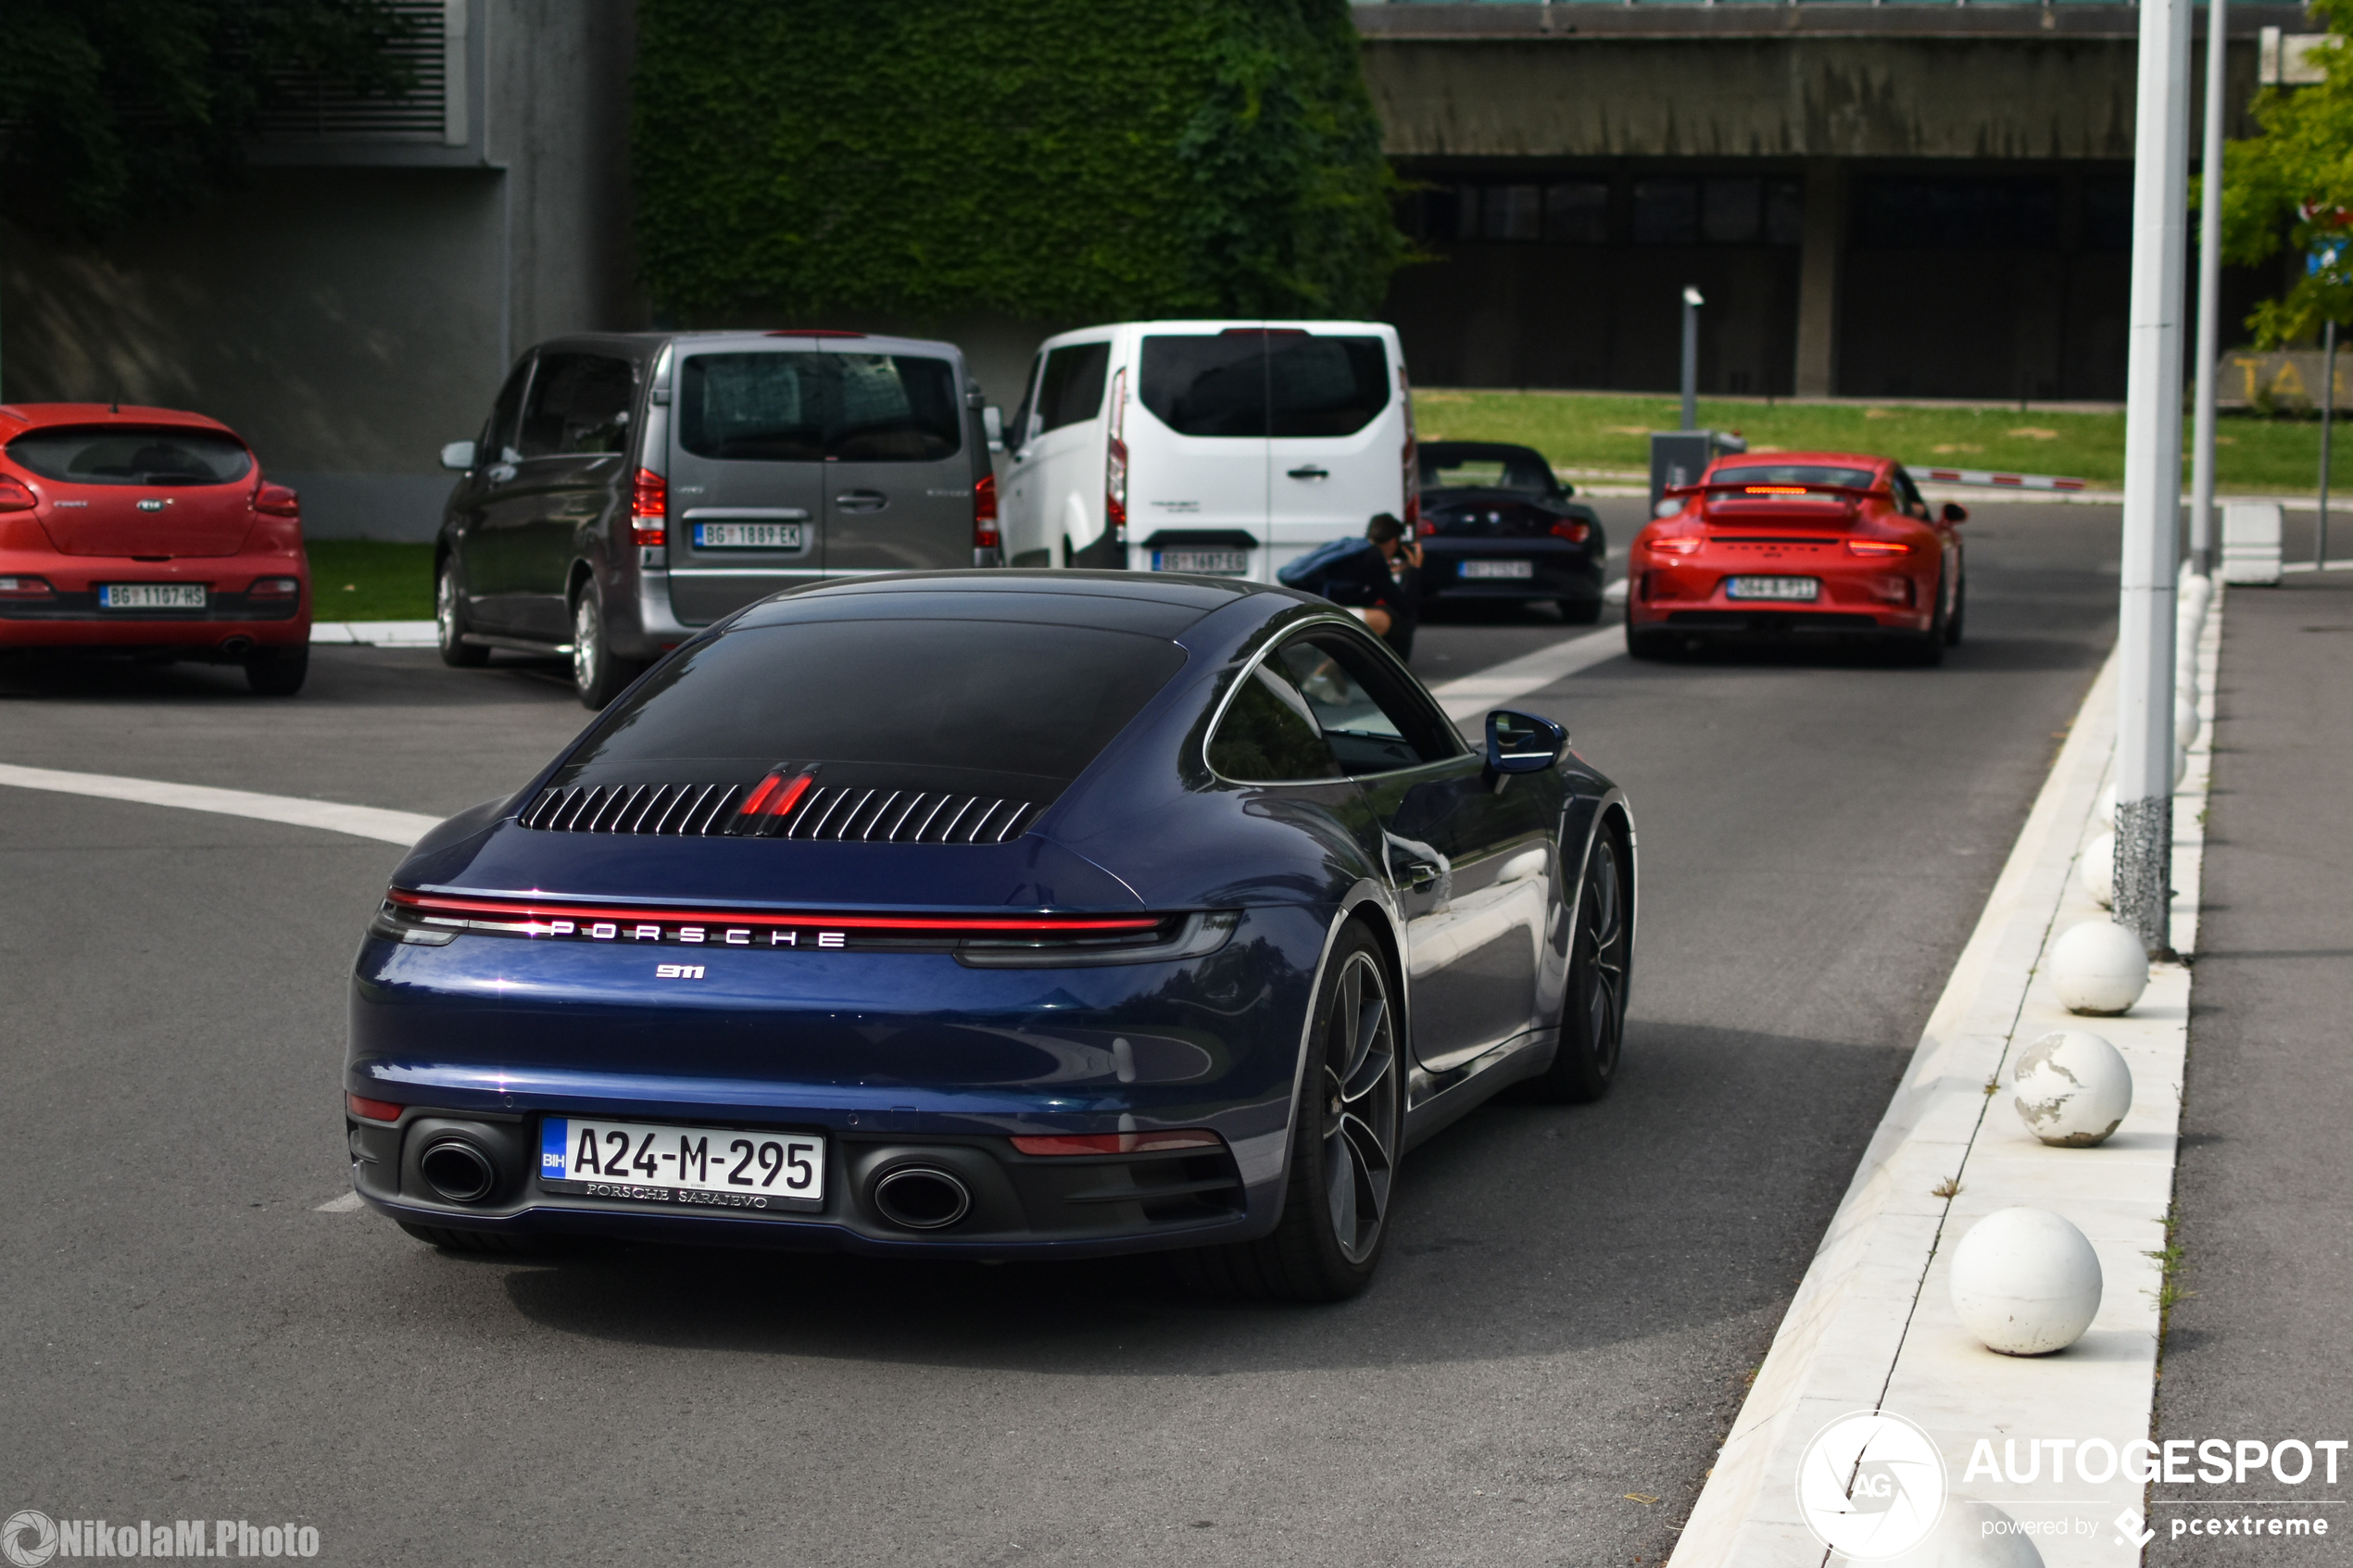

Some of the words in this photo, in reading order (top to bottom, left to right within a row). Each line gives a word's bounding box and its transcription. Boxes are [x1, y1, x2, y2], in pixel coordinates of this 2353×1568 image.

[707, 526, 724, 543] BG
[112, 587, 131, 604] BG
[550, 921, 846, 947] PORSCHE
[656, 964, 706, 980] 911
[543, 1152, 565, 1168] BIH
[573, 1127, 813, 1190] A24-M-295
[586, 1184, 670, 1202] PORSCHE
[678, 1190, 768, 1209] SARAJEVO
